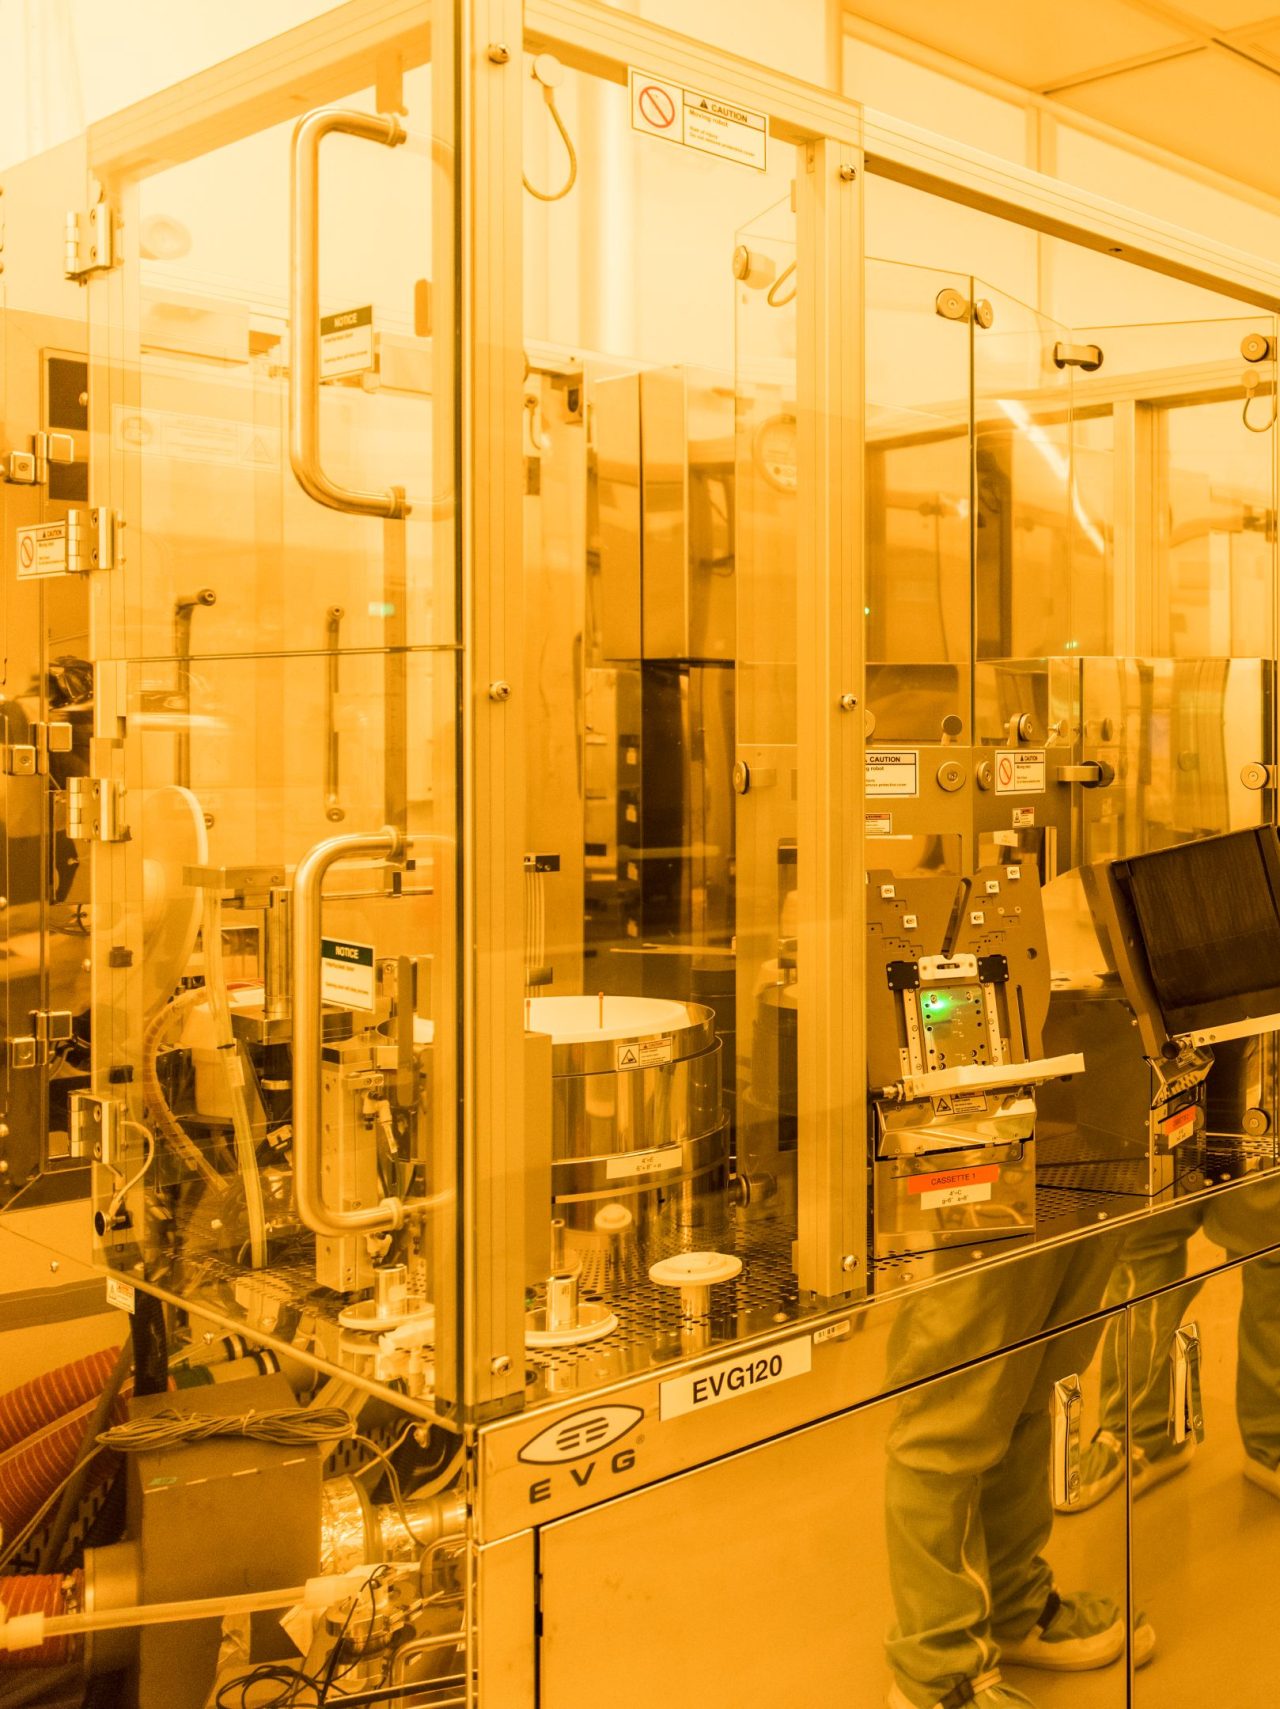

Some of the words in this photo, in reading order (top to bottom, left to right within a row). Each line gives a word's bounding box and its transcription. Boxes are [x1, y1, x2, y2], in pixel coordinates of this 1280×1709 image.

[711, 104, 748, 123] CAUTION
[334, 312, 358, 328] NOTICE
[47, 529, 62, 537] CAUTION
[335, 945, 359, 960] NOTICE
[931, 1173, 970, 1186] CASSETTE
[692, 1354, 783, 1405] EVG120
[529, 1448, 636, 1504] EVG
